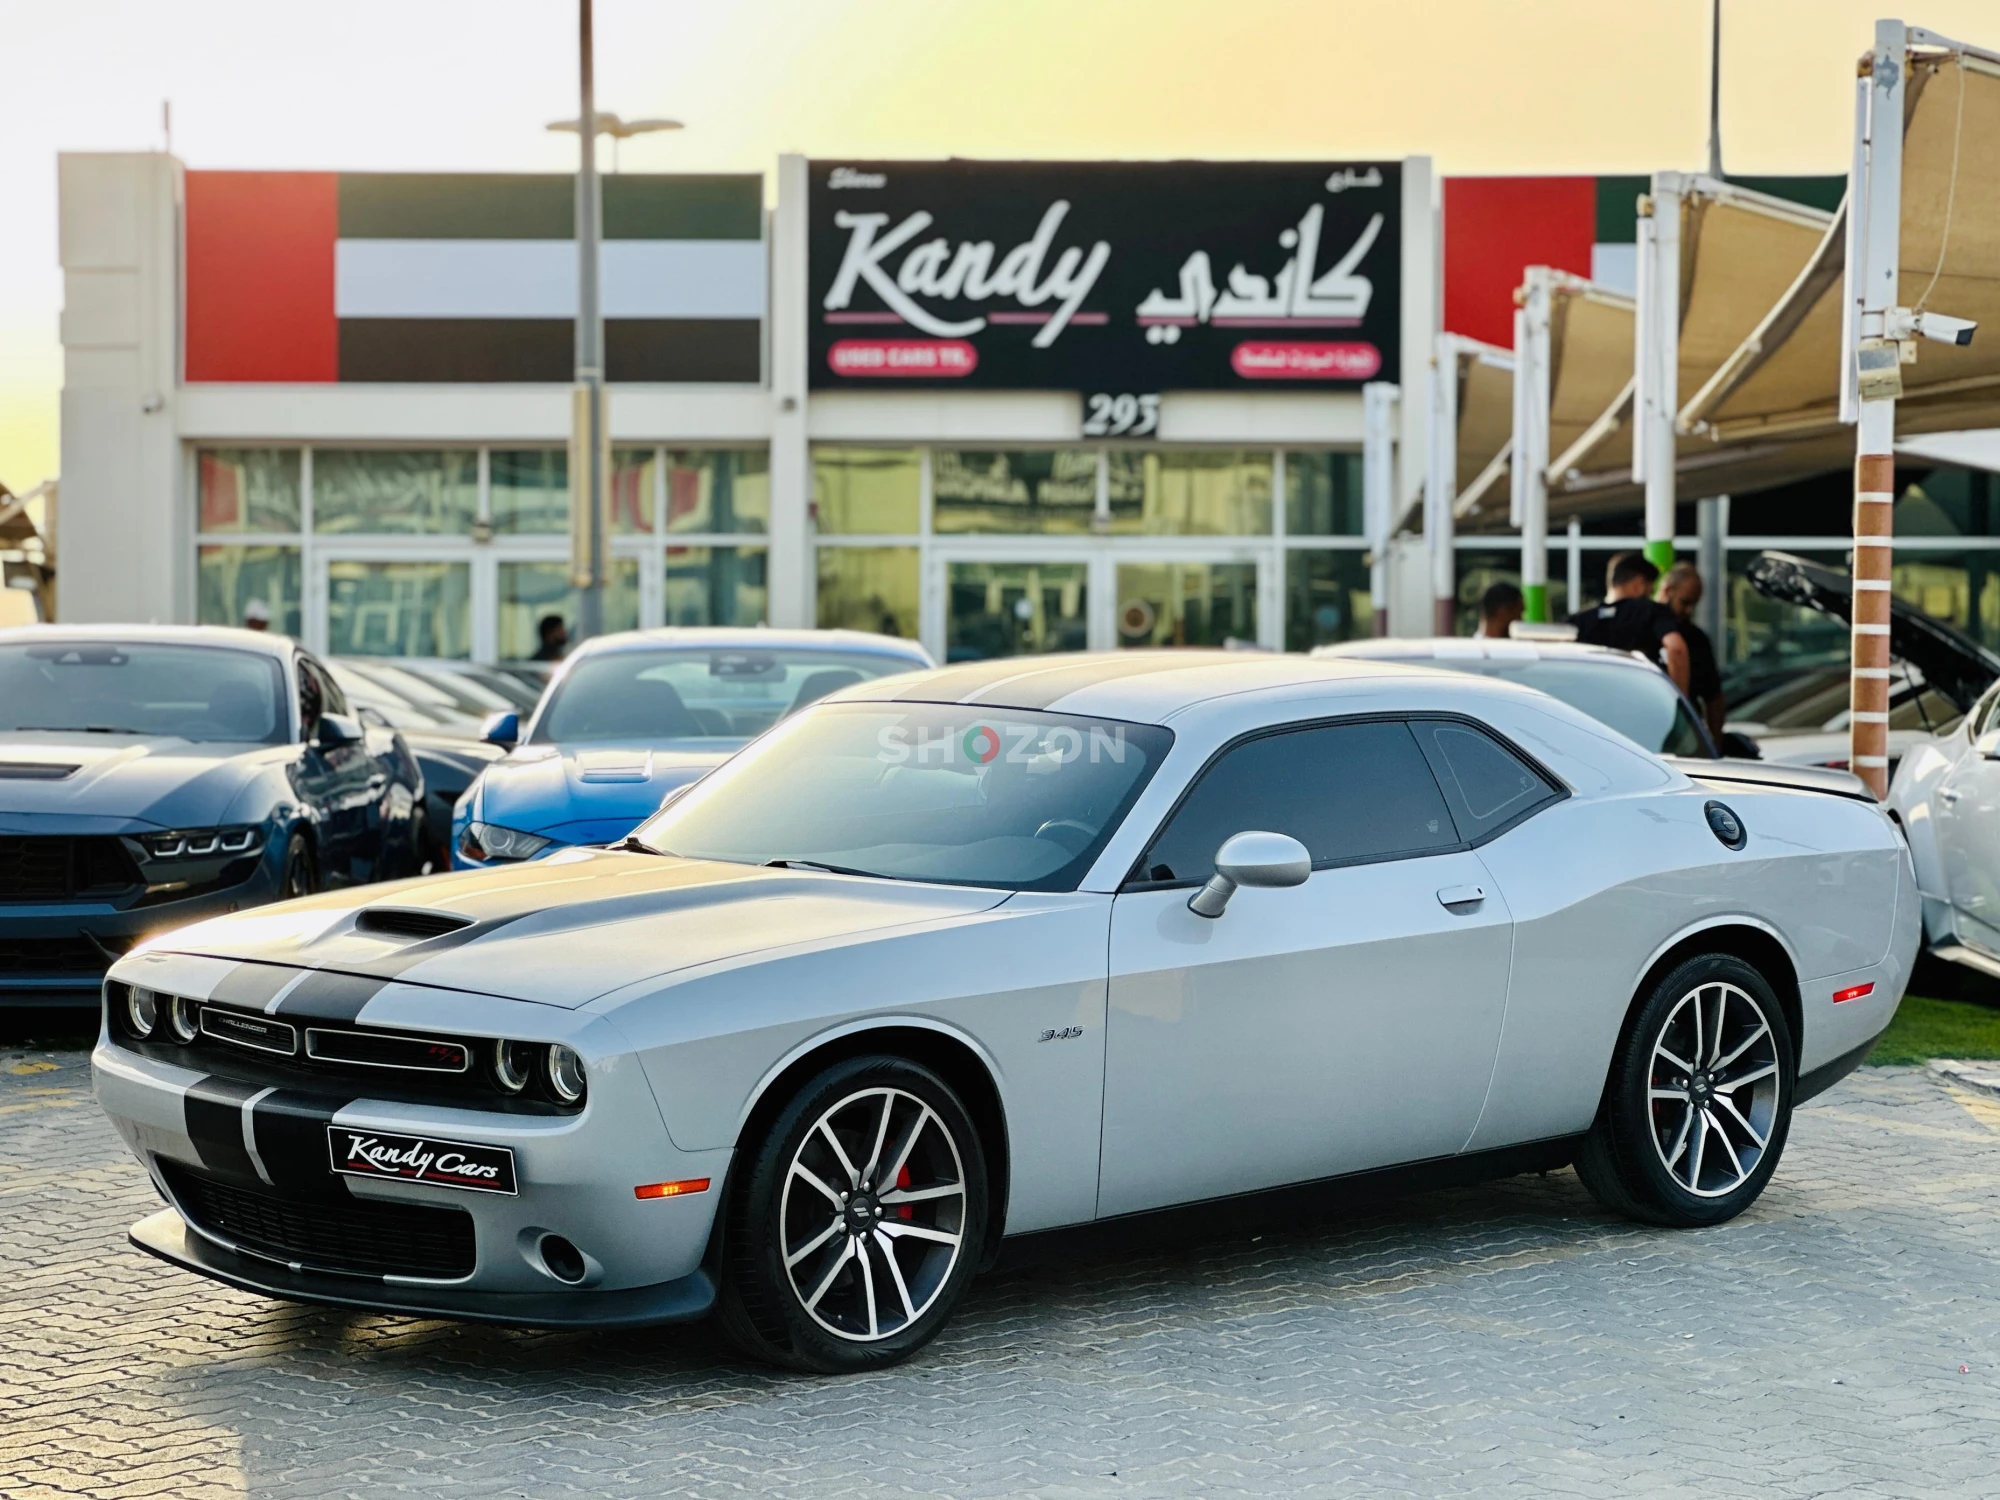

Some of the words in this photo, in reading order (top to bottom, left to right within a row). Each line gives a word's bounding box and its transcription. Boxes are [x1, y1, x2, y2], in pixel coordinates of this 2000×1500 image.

[823, 199, 1110, 347] Kandy
[1136, 202, 1384, 344] كاندي
[1083, 392, 1160, 436] 295
[218, 1017, 267, 1034] CHALLENGER
[1038, 1025, 1085, 1042] 345
[347, 1134, 434, 1178] Kandy
[435, 1153, 499, 1178] Cars
